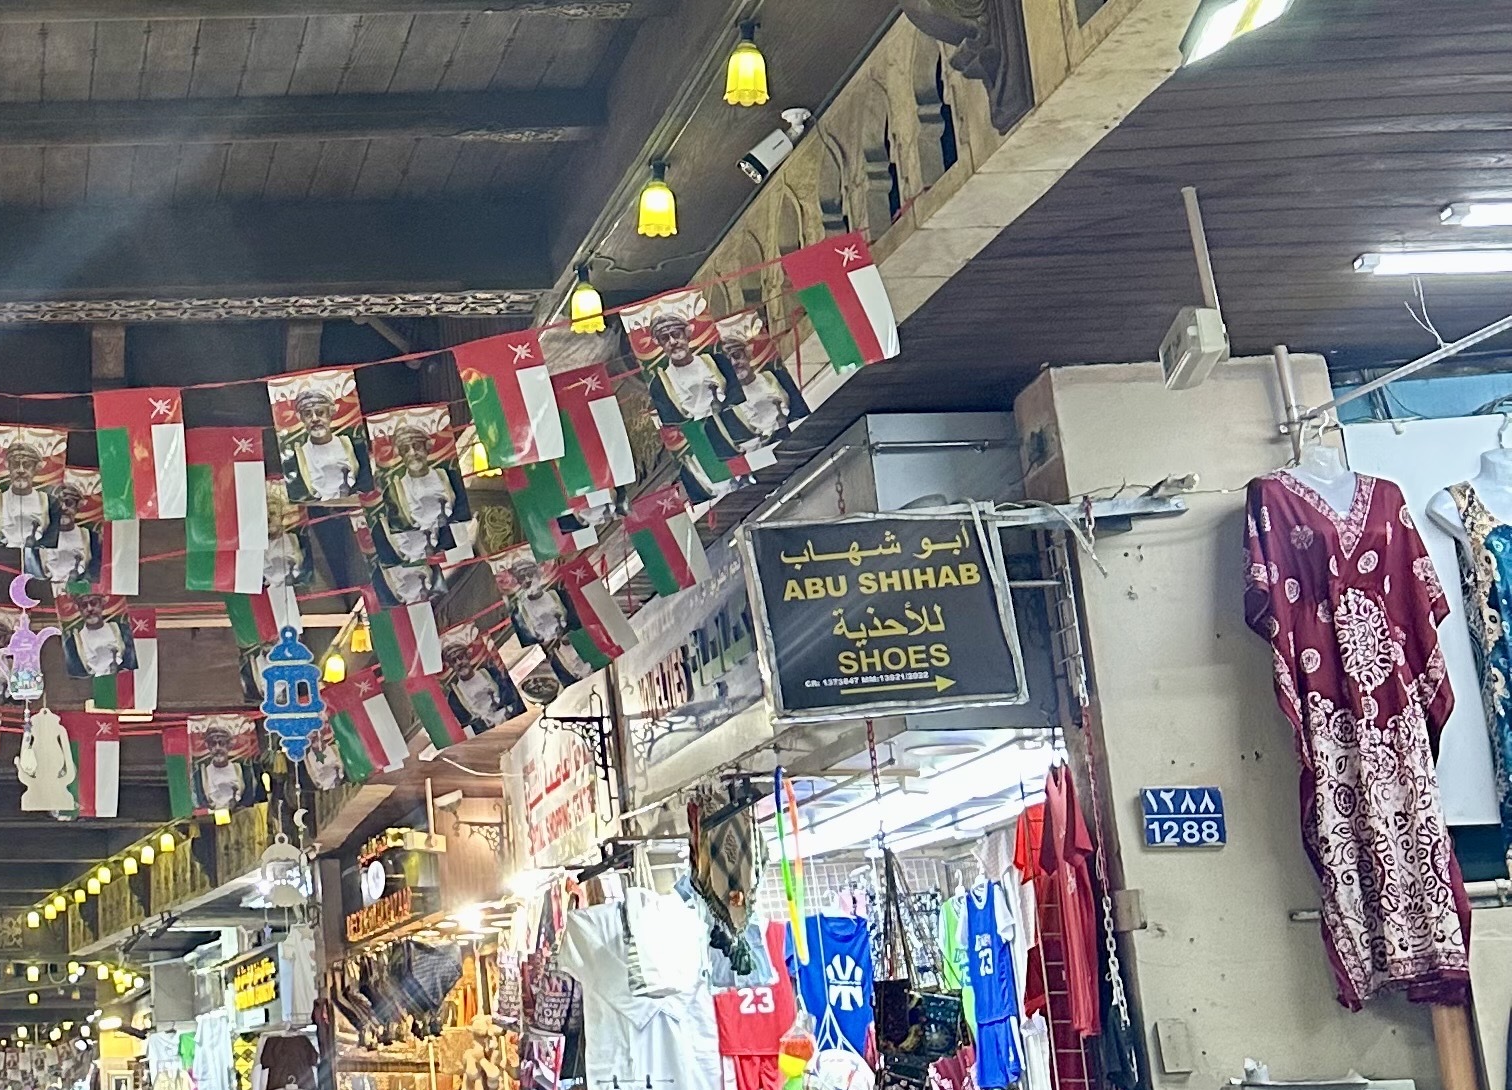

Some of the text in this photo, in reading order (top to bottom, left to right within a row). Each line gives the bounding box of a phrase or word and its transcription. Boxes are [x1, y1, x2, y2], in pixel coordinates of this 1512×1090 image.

[780, 520, 971, 571] أبو شهاب
[783, 563, 981, 601] ABU SHIHAB
[832, 602, 946, 648] للأحذية
[838, 644, 952, 674] SHOES
[1145, 789, 1216, 813] ١٢٨٨
[1148, 821, 1220, 843] 1288
[737, 986, 776, 1015] 23
